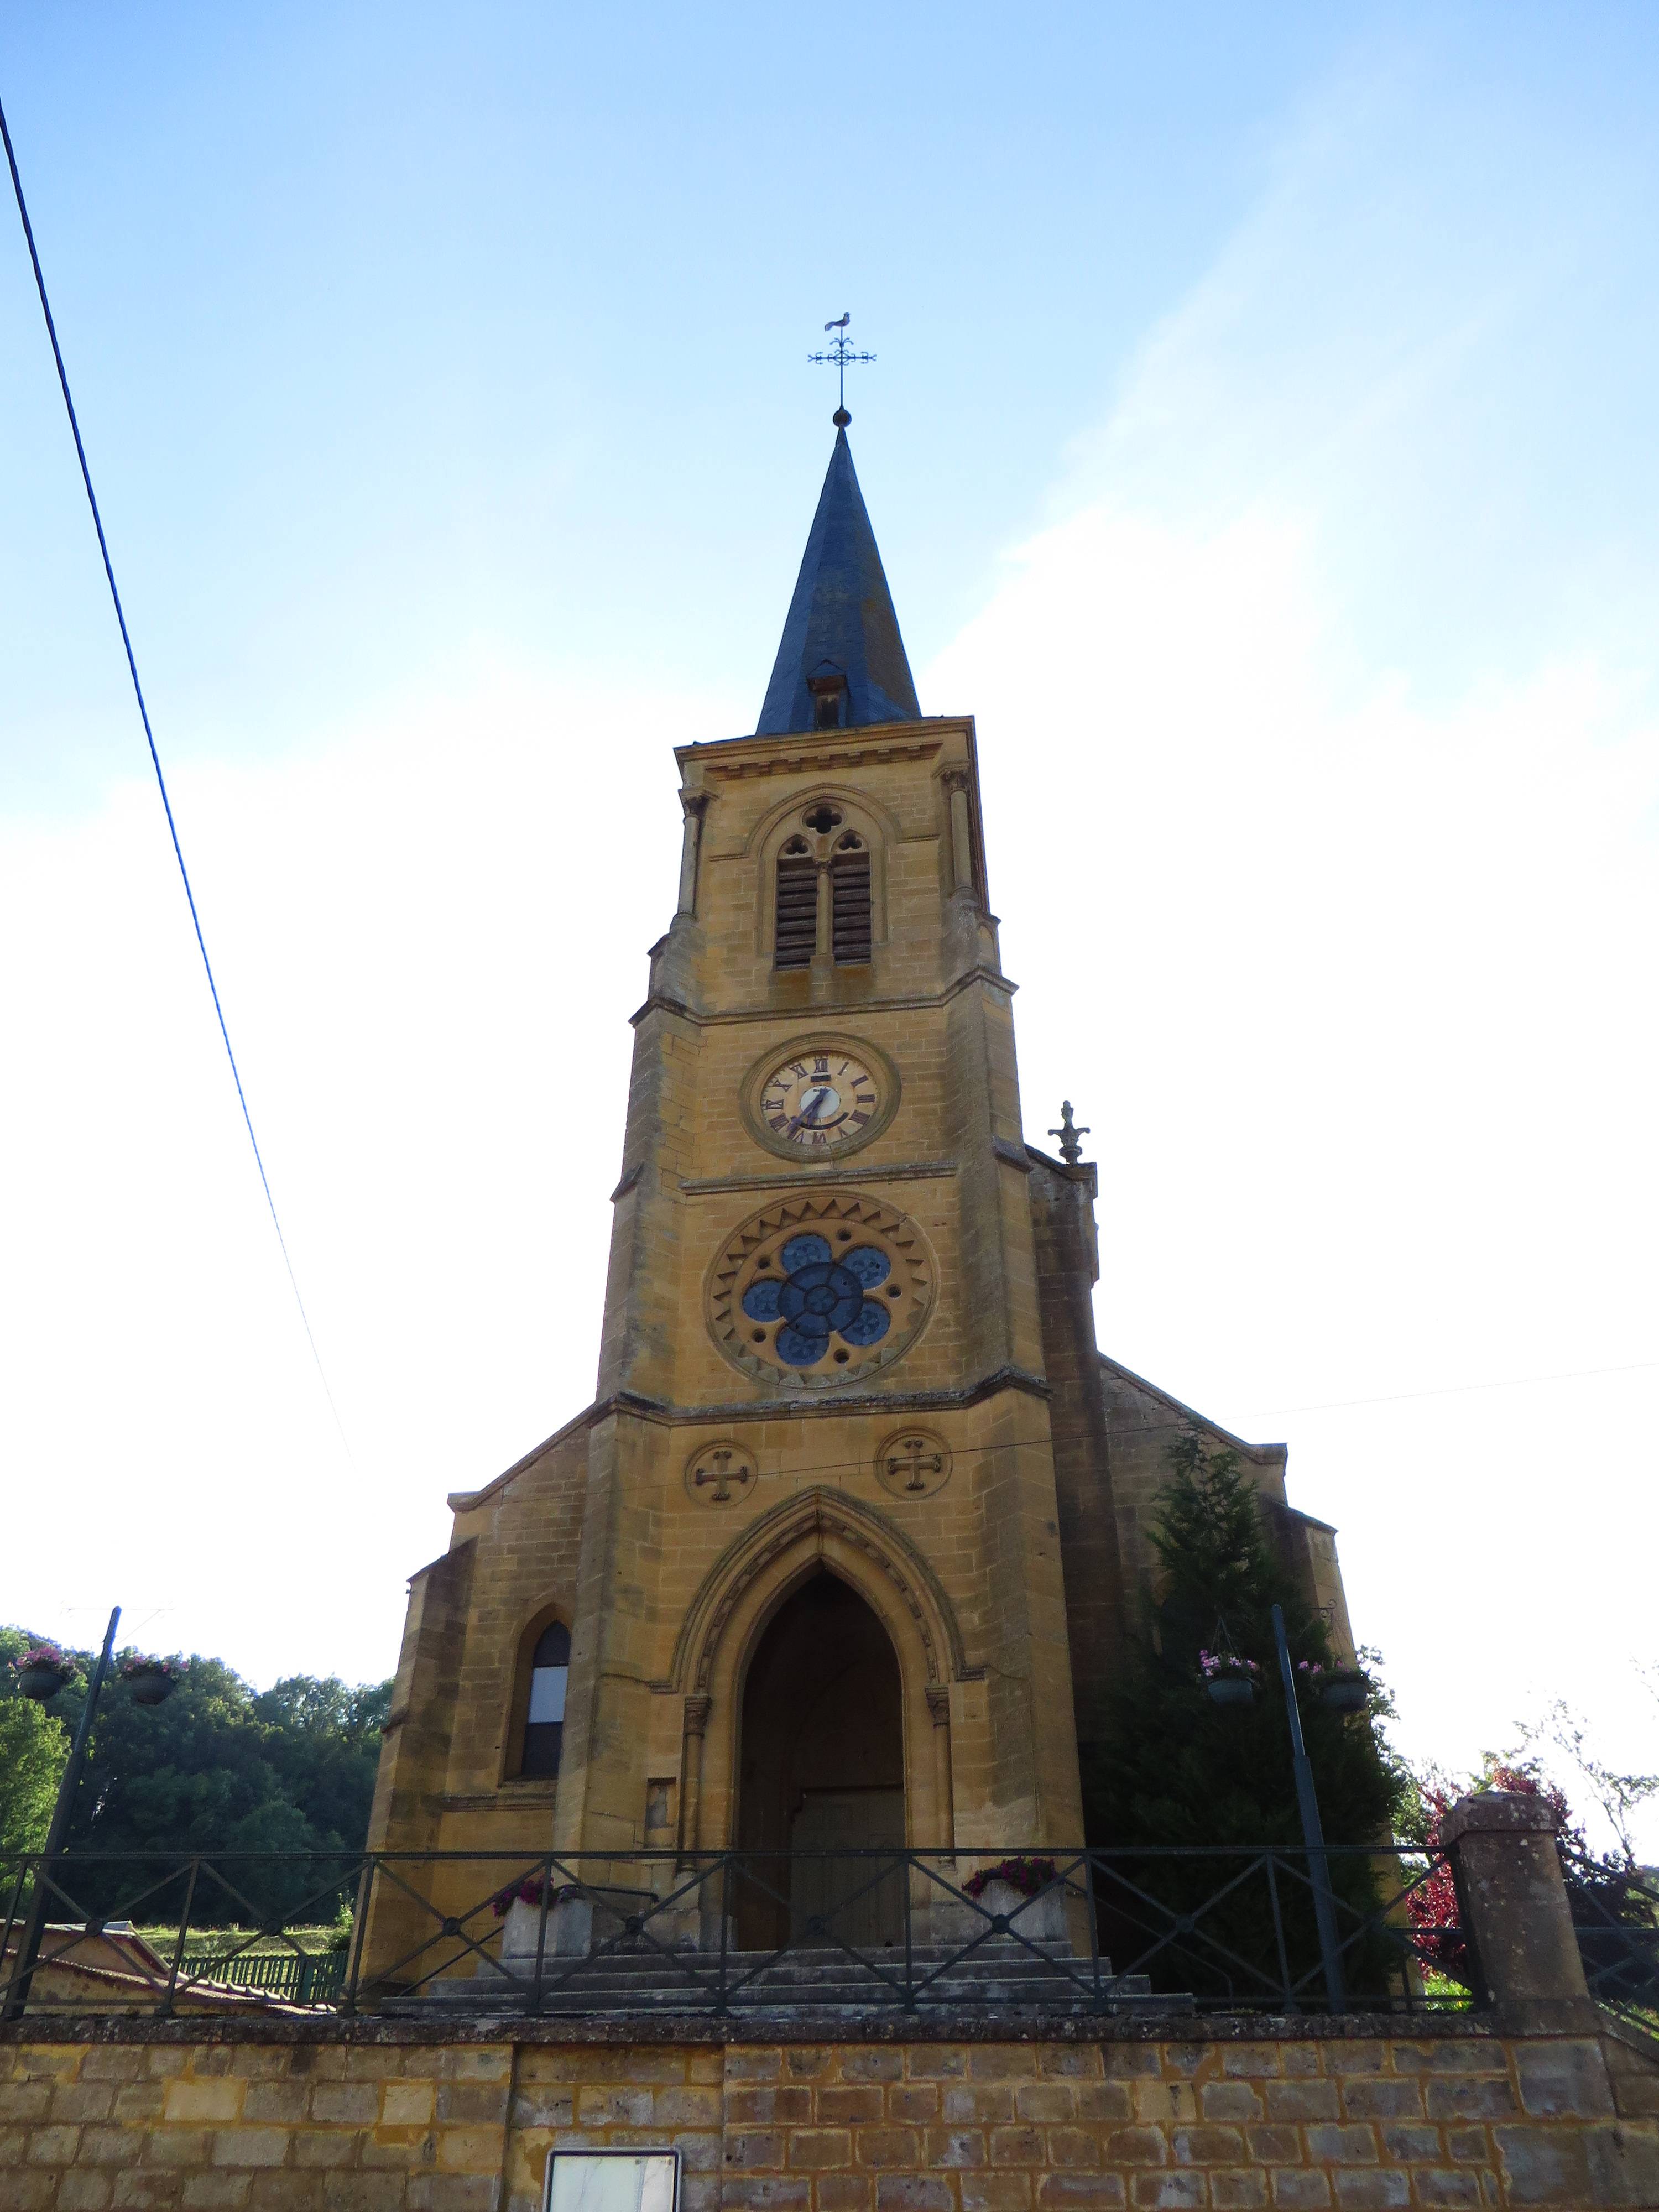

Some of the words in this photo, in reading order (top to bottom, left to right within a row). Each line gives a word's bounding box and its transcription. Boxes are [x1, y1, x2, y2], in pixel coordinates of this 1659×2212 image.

[790, 1063, 809, 1079] XI
[814, 1058, 828, 1073] XII
[837, 1061, 849, 1076] I
[773, 1080, 793, 1092] X
[851, 1075, 868, 1088] II
[766, 1099, 784, 1109] IX
[856, 1094, 875, 1104] III
[769, 1113, 789, 1133] VIII
[812, 1131, 827, 1144] VI
